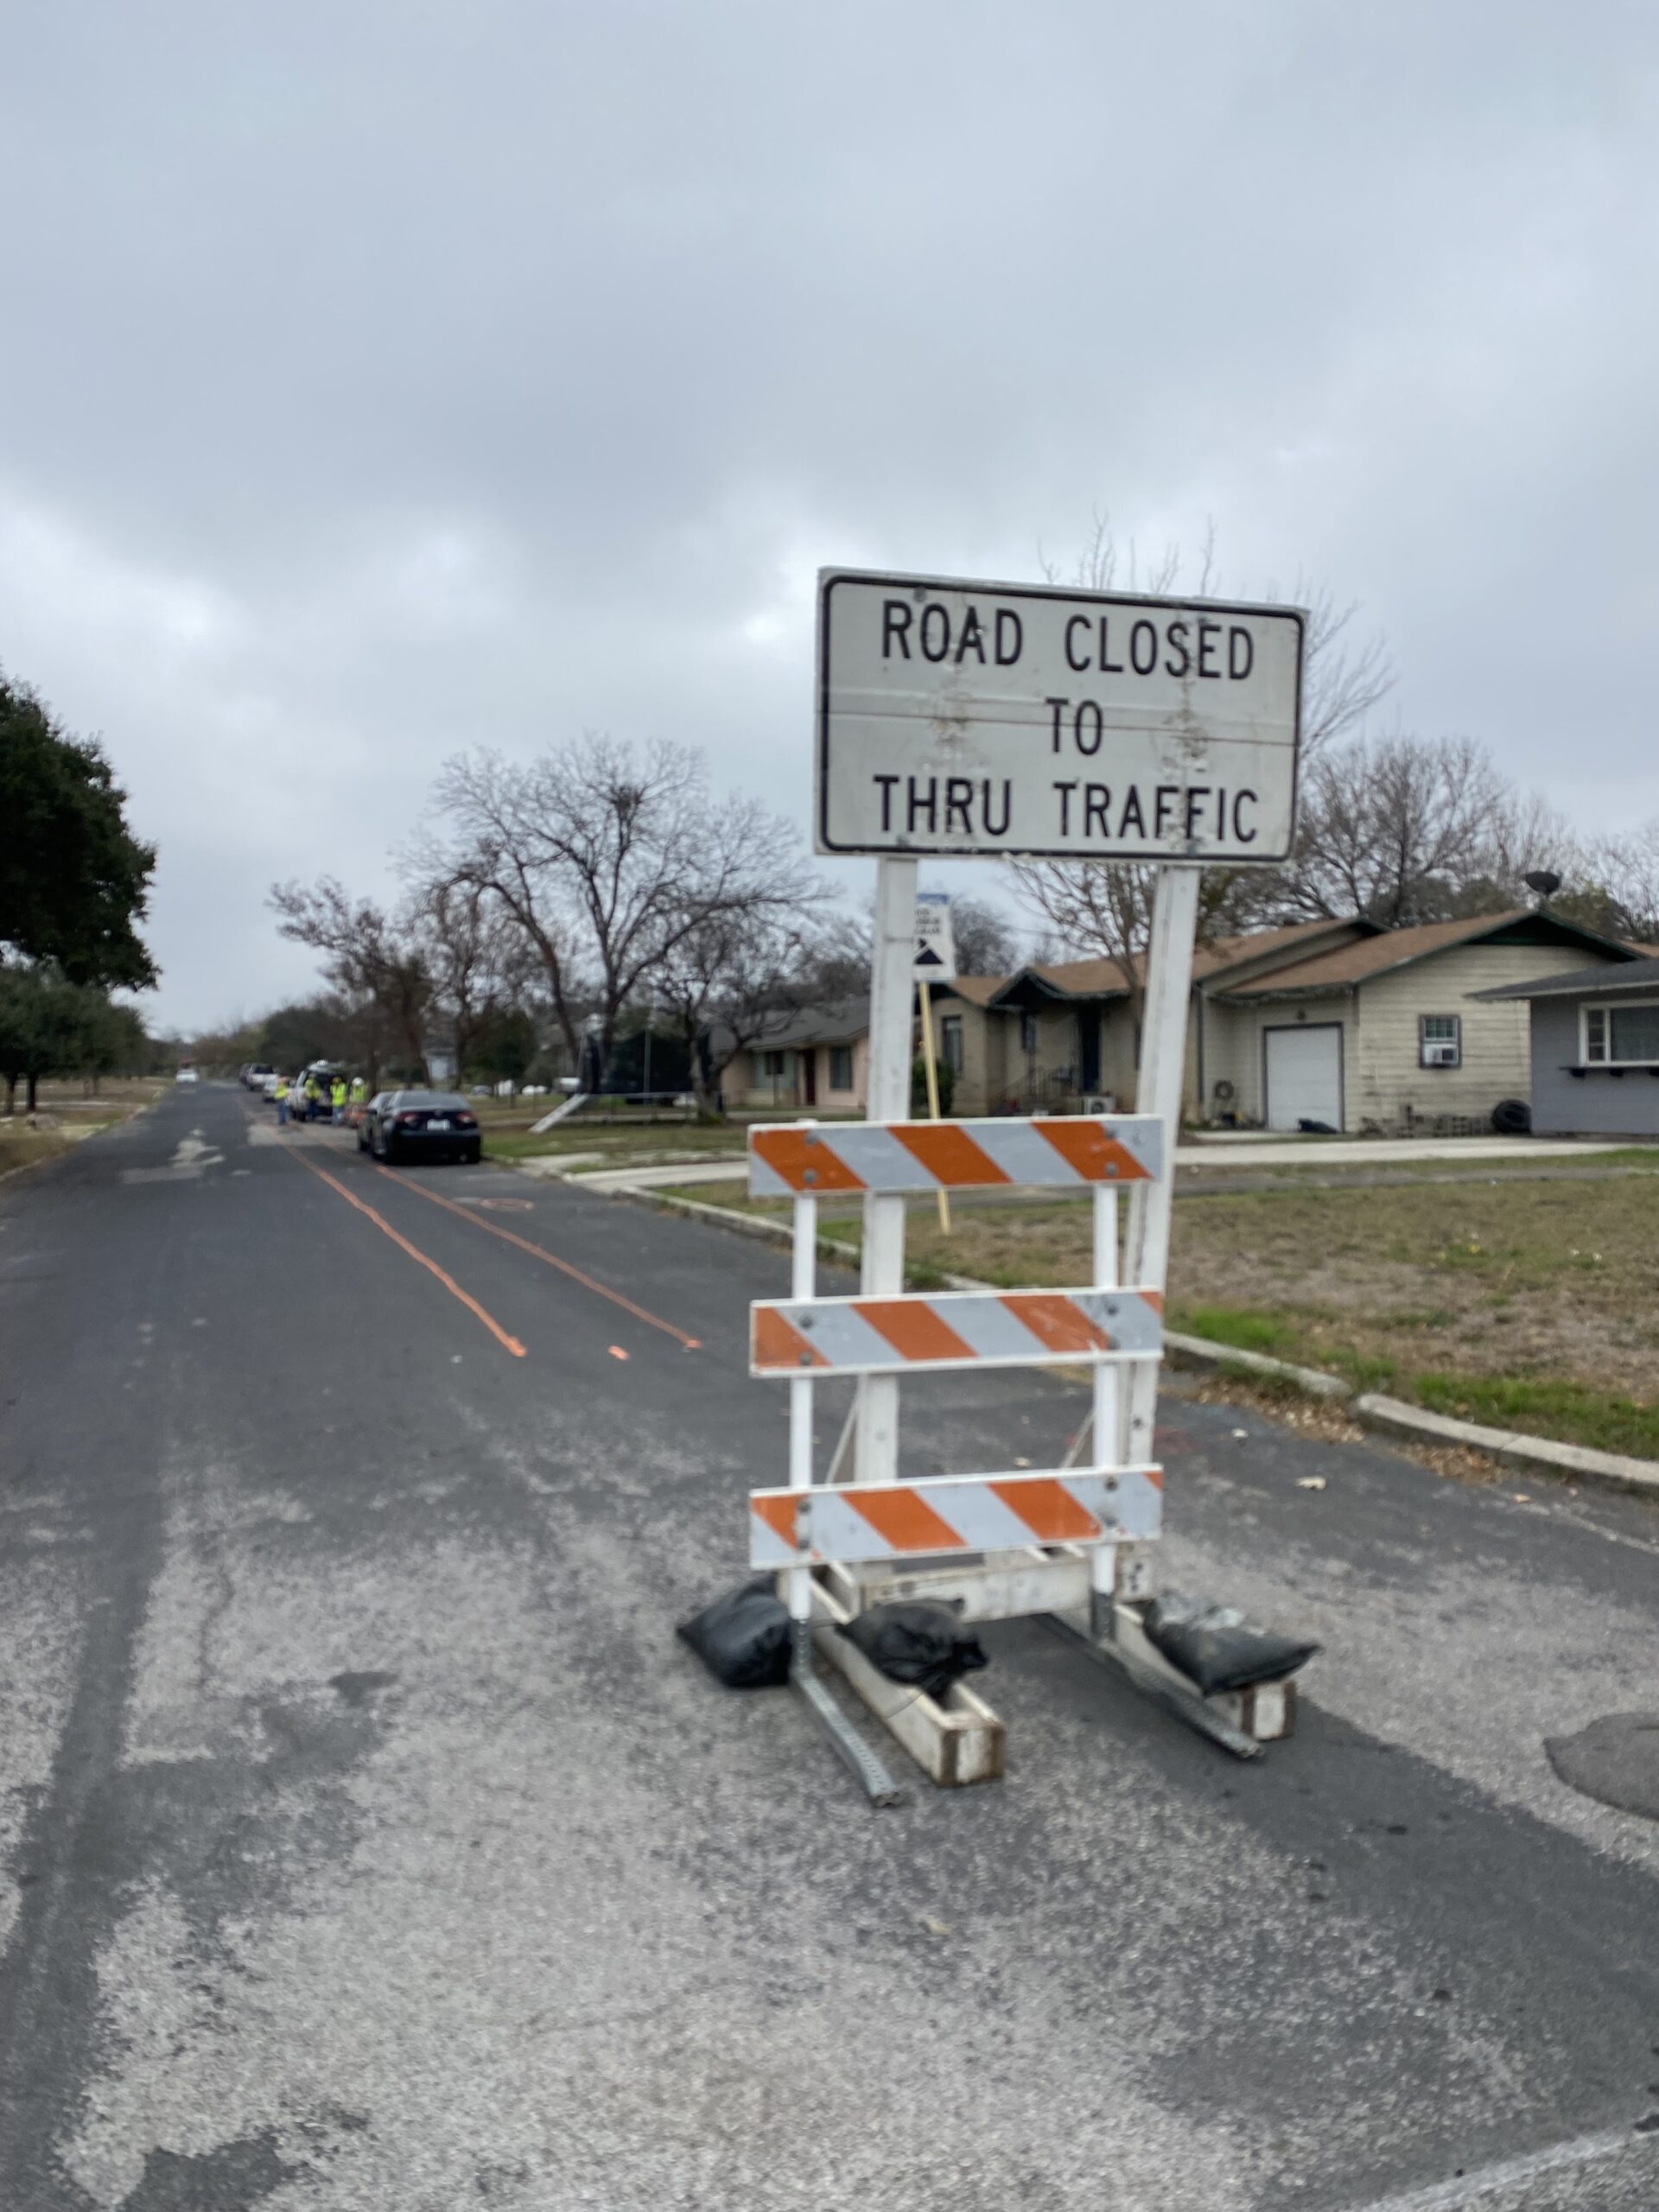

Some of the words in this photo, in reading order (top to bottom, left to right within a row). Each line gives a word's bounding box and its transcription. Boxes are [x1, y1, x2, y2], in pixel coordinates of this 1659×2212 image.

[881, 601, 1023, 664] ROAD
[1065, 614, 1254, 679] CLOSED
[1045, 697, 1104, 754] TO
[874, 775, 1011, 836] THRU
[1053, 782, 1258, 843] TRAFFIC
